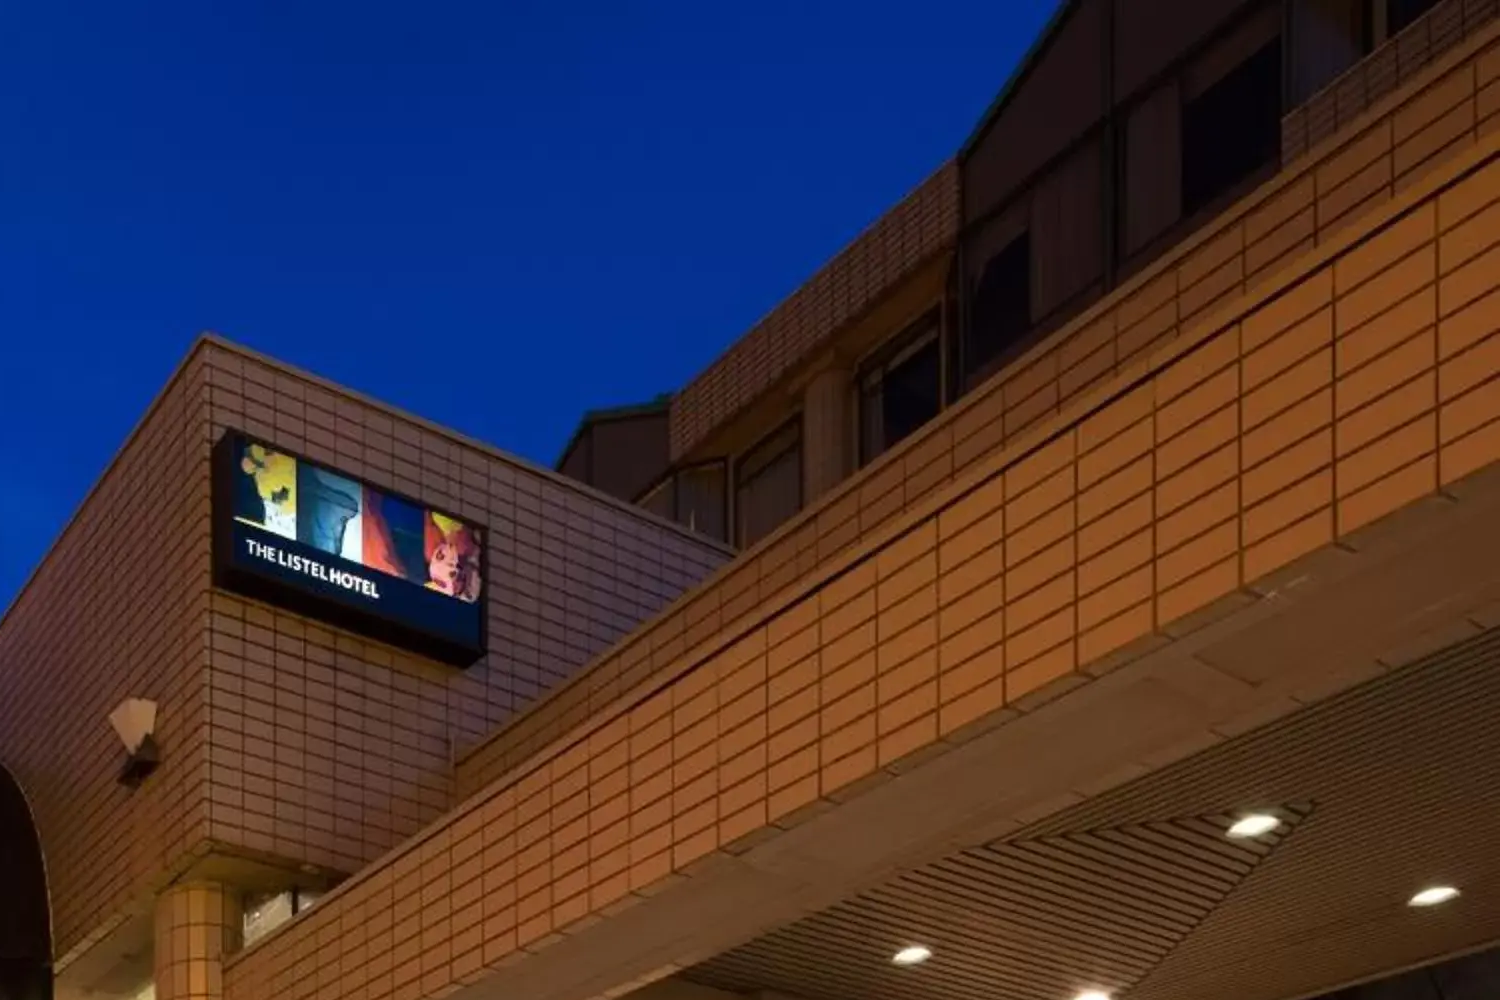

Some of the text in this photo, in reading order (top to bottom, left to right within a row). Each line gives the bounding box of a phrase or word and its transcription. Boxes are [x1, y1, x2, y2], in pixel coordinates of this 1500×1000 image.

[245, 538, 380, 599] THE LISTEL HOTEL
